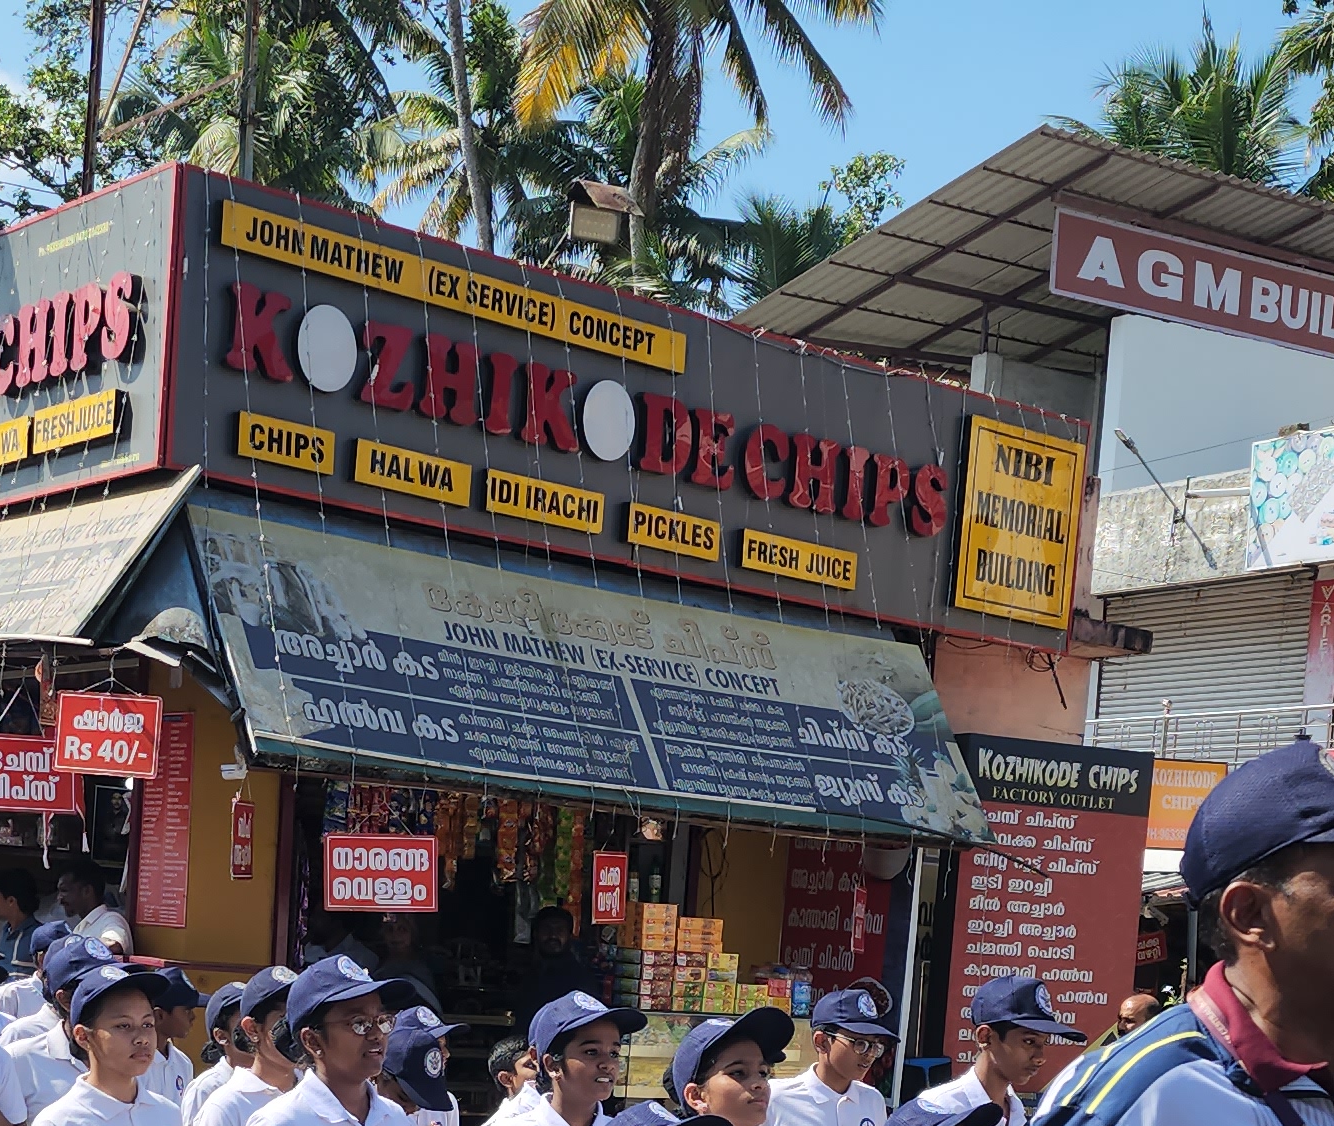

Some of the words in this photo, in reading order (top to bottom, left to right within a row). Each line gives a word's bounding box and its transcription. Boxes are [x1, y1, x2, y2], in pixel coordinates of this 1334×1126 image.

[246, 217, 304, 256] JOHN
[310, 230, 403, 283] MATHEW
[428, 266, 460, 301] (EX
[467, 274, 556, 331] SERVICE)
[569, 311, 656, 354] CONCEPT
[35, 410, 74, 444] FRESH
[75, 399, 113, 432] JUICE
[249, 424, 325, 464] CHIPS
[994, 442, 1055, 486] NIBI
[369, 449, 453, 492] HALWA
[745, 424, 947, 537] CHIPS
[490, 476, 522, 509] IDI
[526, 482, 598, 524] IRACHI
[977, 492, 1065, 545] MEMORIAL
[633, 510, 714, 550] PICKLES
[747, 539, 800, 571] FRESH
[805, 549, 852, 581] JUICE
[976, 549, 1055, 597] BUILDING
[393, 652, 440, 680] കട
[443, 620, 499, 650] JOHN
[503, 632, 585, 665] MATHEW
[590, 644, 701, 688] (EX-SERVICE)
[705, 668, 781, 697] CONCEPT
[303, 698, 407, 735] ഹൽവ
[412, 713, 460, 743] കട
[64, 736, 92, 760] Rs
[97, 738, 148, 766] 40/-
[978, 748, 1082, 789] KOZHIKODE
[1088, 765, 1139, 793] CHIPS
[992, 786, 1057, 805] FACTORY
[1060, 793, 1115, 810] OUTLET
[1025, 811, 1078, 830] ചിപ്സ്
[332, 846, 429, 873] നാരങ്ങ
[1042, 834, 1095, 854] ചിപ്സ്
[1047, 859, 1100, 876] ചിപ്സ്
[332, 877, 427, 905] വെള്ളം
[1006, 900, 1065, 919] അച്ചാർ
[1019, 922, 1077, 941] അച്ചാർ
